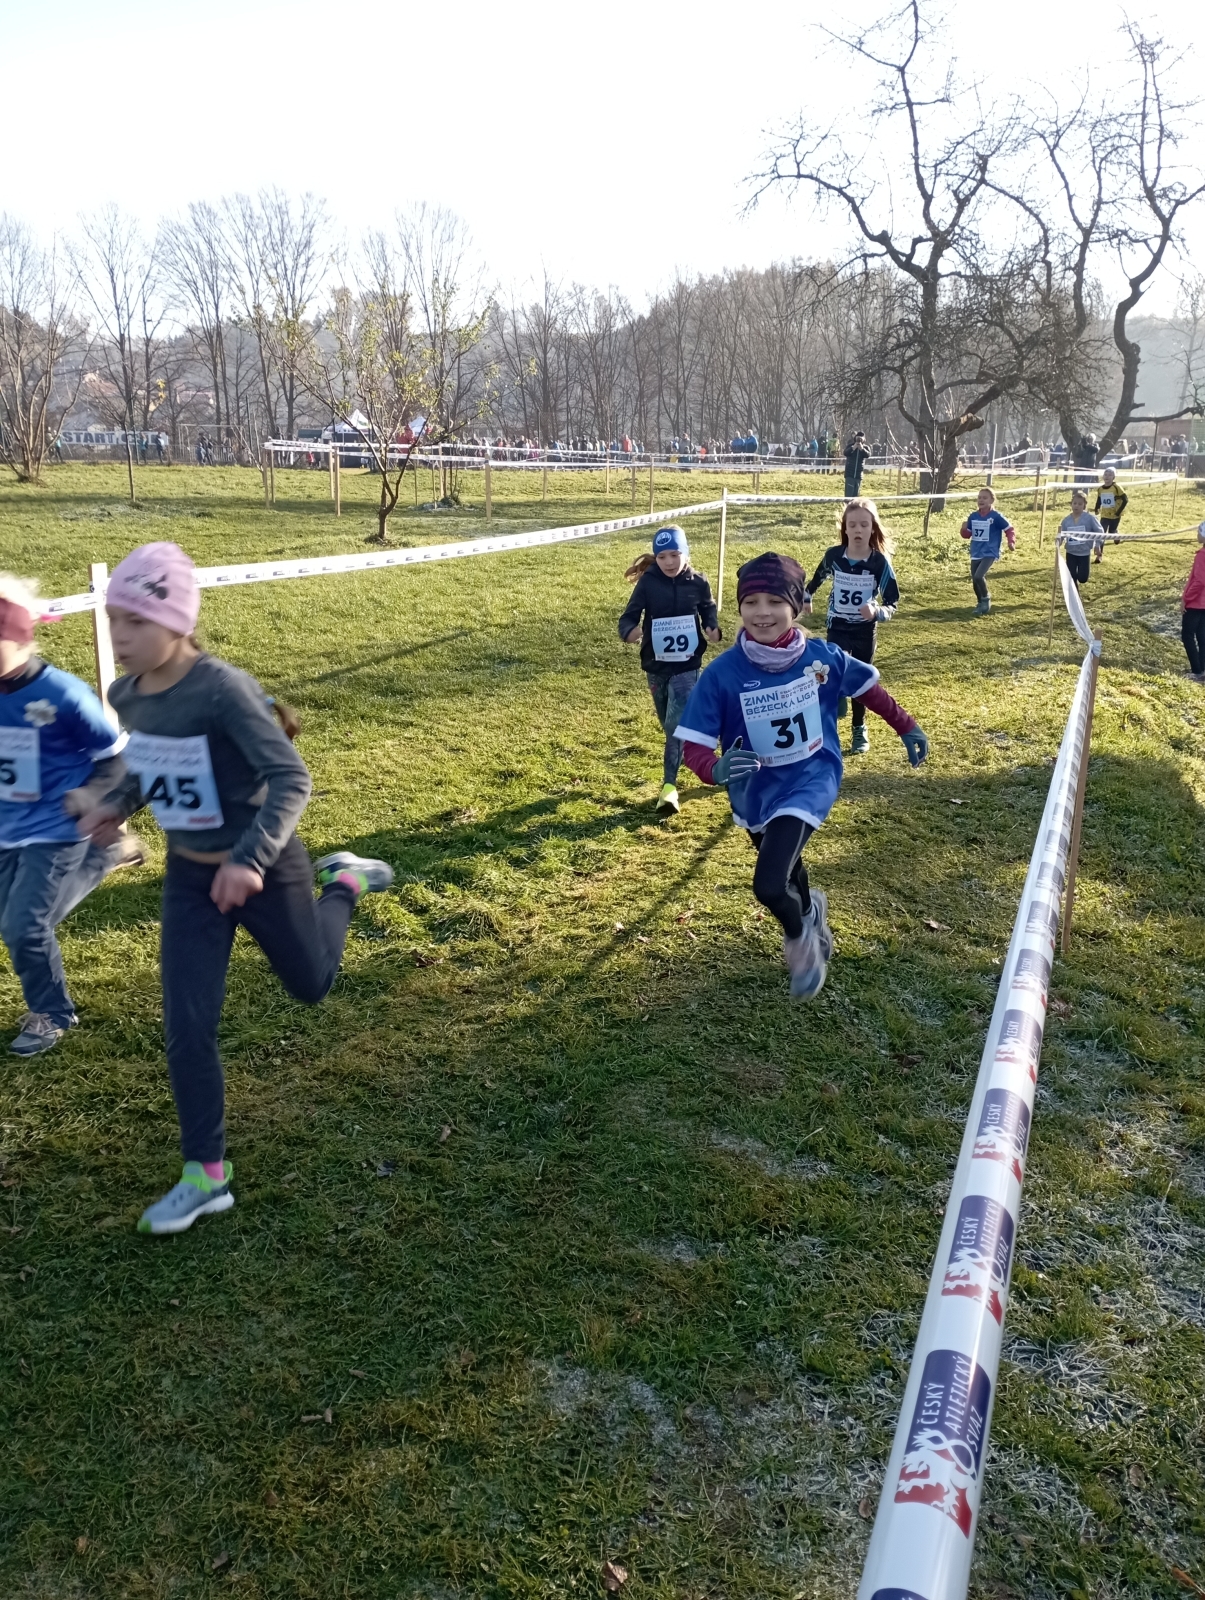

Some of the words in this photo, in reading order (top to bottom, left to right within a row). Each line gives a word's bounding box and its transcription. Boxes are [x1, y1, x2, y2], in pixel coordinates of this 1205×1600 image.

[974, 528, 985, 537] 37
[839, 589, 863, 606] 36
[663, 634, 689, 653] 29
[743, 690, 779, 707] ZIMNÍ
[745, 699, 796, 716] BĚŽECKÁ
[796, 690, 816, 704] LIGA
[770, 712, 808, 749] 31
[149, 775, 203, 810] 45
[983, 1103, 1002, 1124] ČESKÝ
[956, 1216, 980, 1246] ČESKÝ
[980, 1199, 1000, 1253] ATLETICKÝ
[997, 1235, 1009, 1270] SVAZ
[916, 1382, 945, 1424] ČESKÝ
[944, 1355, 972, 1436] ATLETICKÝ
[966, 1405, 983, 1453] SVAZ
